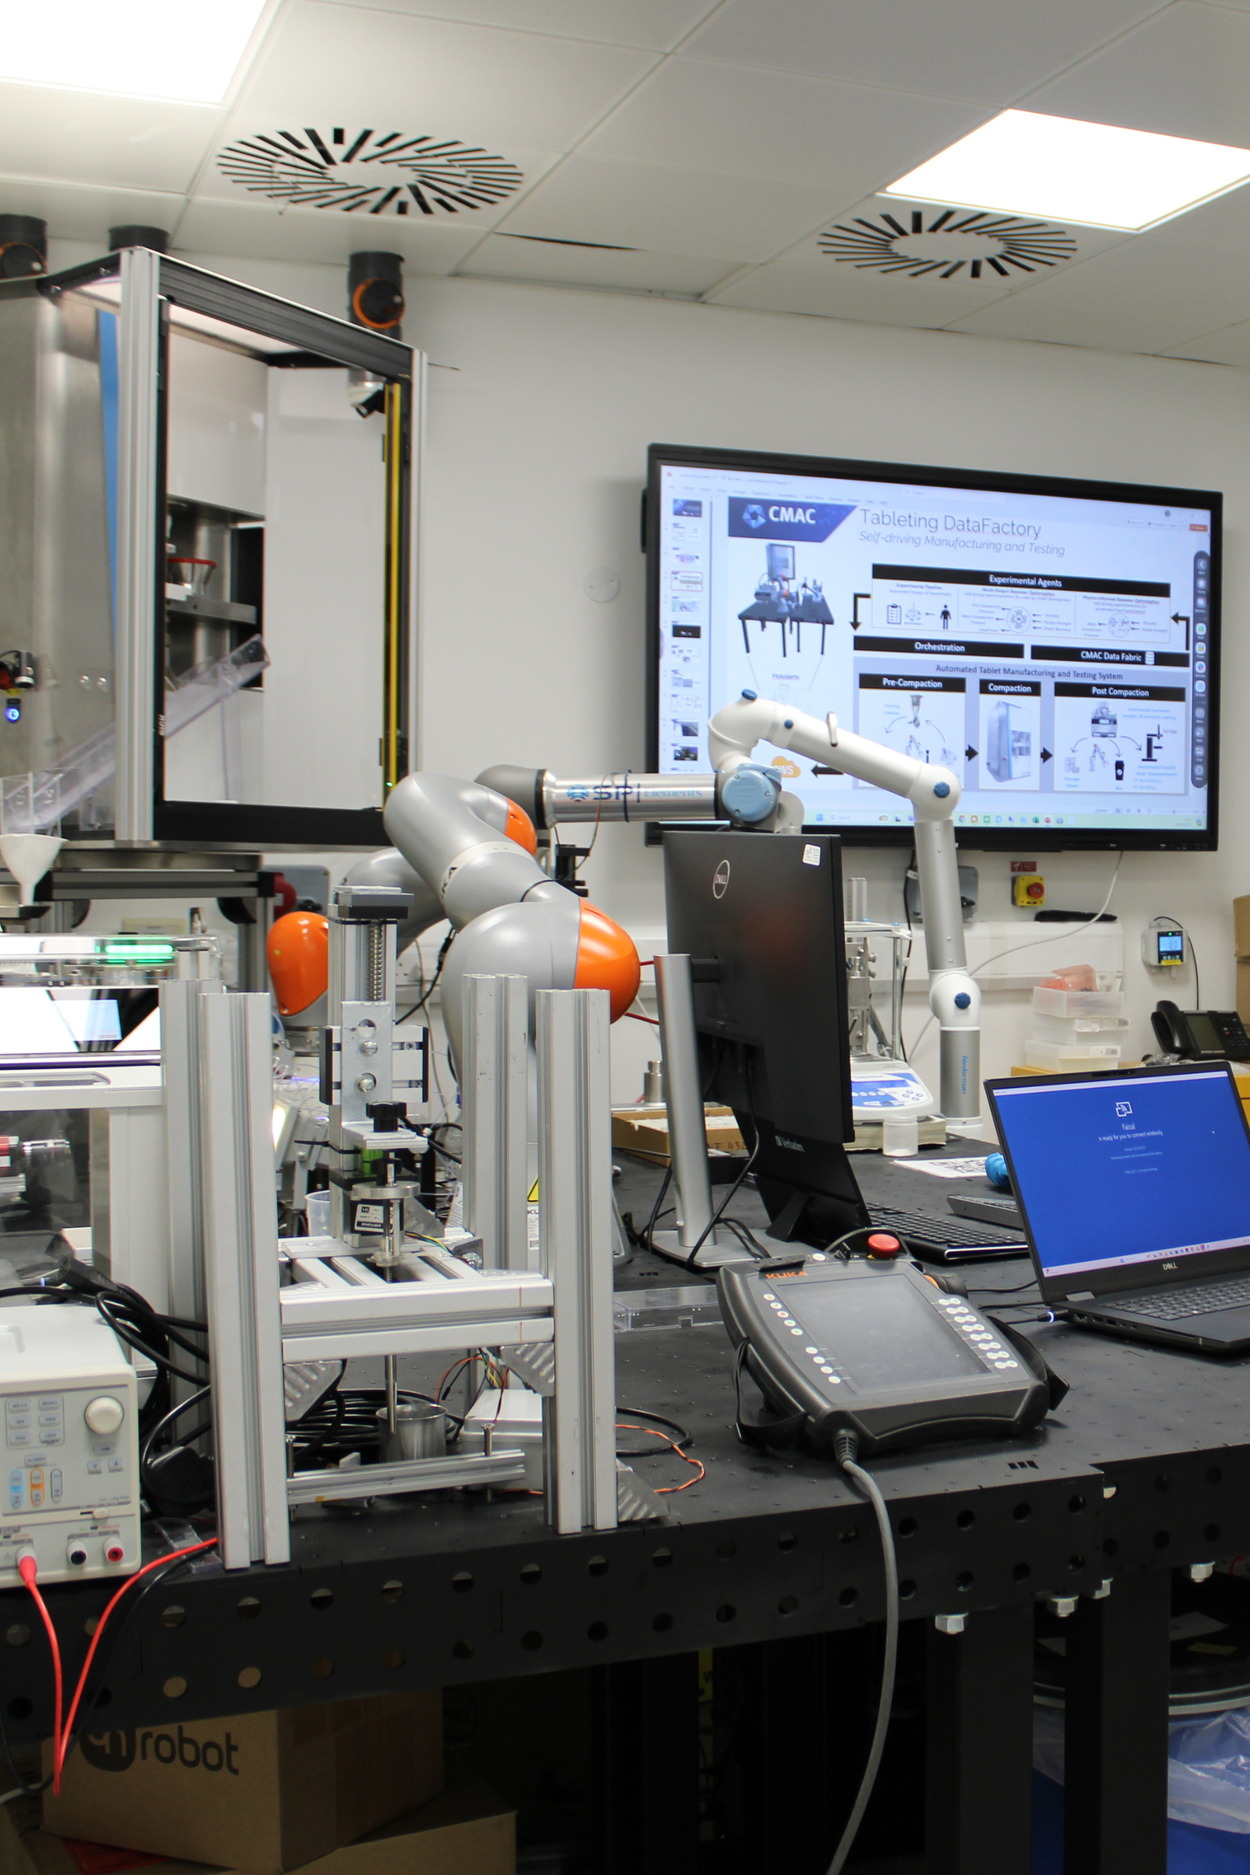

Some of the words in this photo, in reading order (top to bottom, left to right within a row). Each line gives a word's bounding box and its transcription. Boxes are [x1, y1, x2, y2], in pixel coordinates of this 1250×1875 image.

[768, 506, 816, 524] CMAC
[860, 508, 938, 533] Tableting
[944, 514, 1042, 540] DataFactory
[859, 530, 922, 548] Self-driving
[924, 536, 1002, 552] Manufacturing
[1005, 540, 1026, 552] and
[1028, 542, 1066, 558] Testing
[989, 574, 1036, 586] Experimental
[1038, 576, 1063, 588] Agents
[914, 642, 966, 652] Orchestration
[1081, 651, 1102, 660] CMAC
[1104, 652, 1120, 661] Data
[1121, 653, 1142, 662] Fabric
[936, 665, 977, 674] Automated
[979, 666, 1001, 674] Tablet
[1003, 668, 1055, 678] Manufacturing
[1073, 671, 1097, 680] Testing
[1098, 672, 1123, 681] System
[883, 678, 943, 688] Pre-Compaction
[988, 683, 1032, 693] Compaction
[1092, 687, 1108, 695] Post
[1108, 688, 1150, 697] Compaction
[592, 786, 633, 800] SP
[644, 786, 702, 798] Elements
[714, 874, 728, 884] DELL
[1122, 1122, 1136, 1130] Faisal
[1163, 1262, 1177, 1270] DELL
[766, 1271, 808, 1279] KUKA
